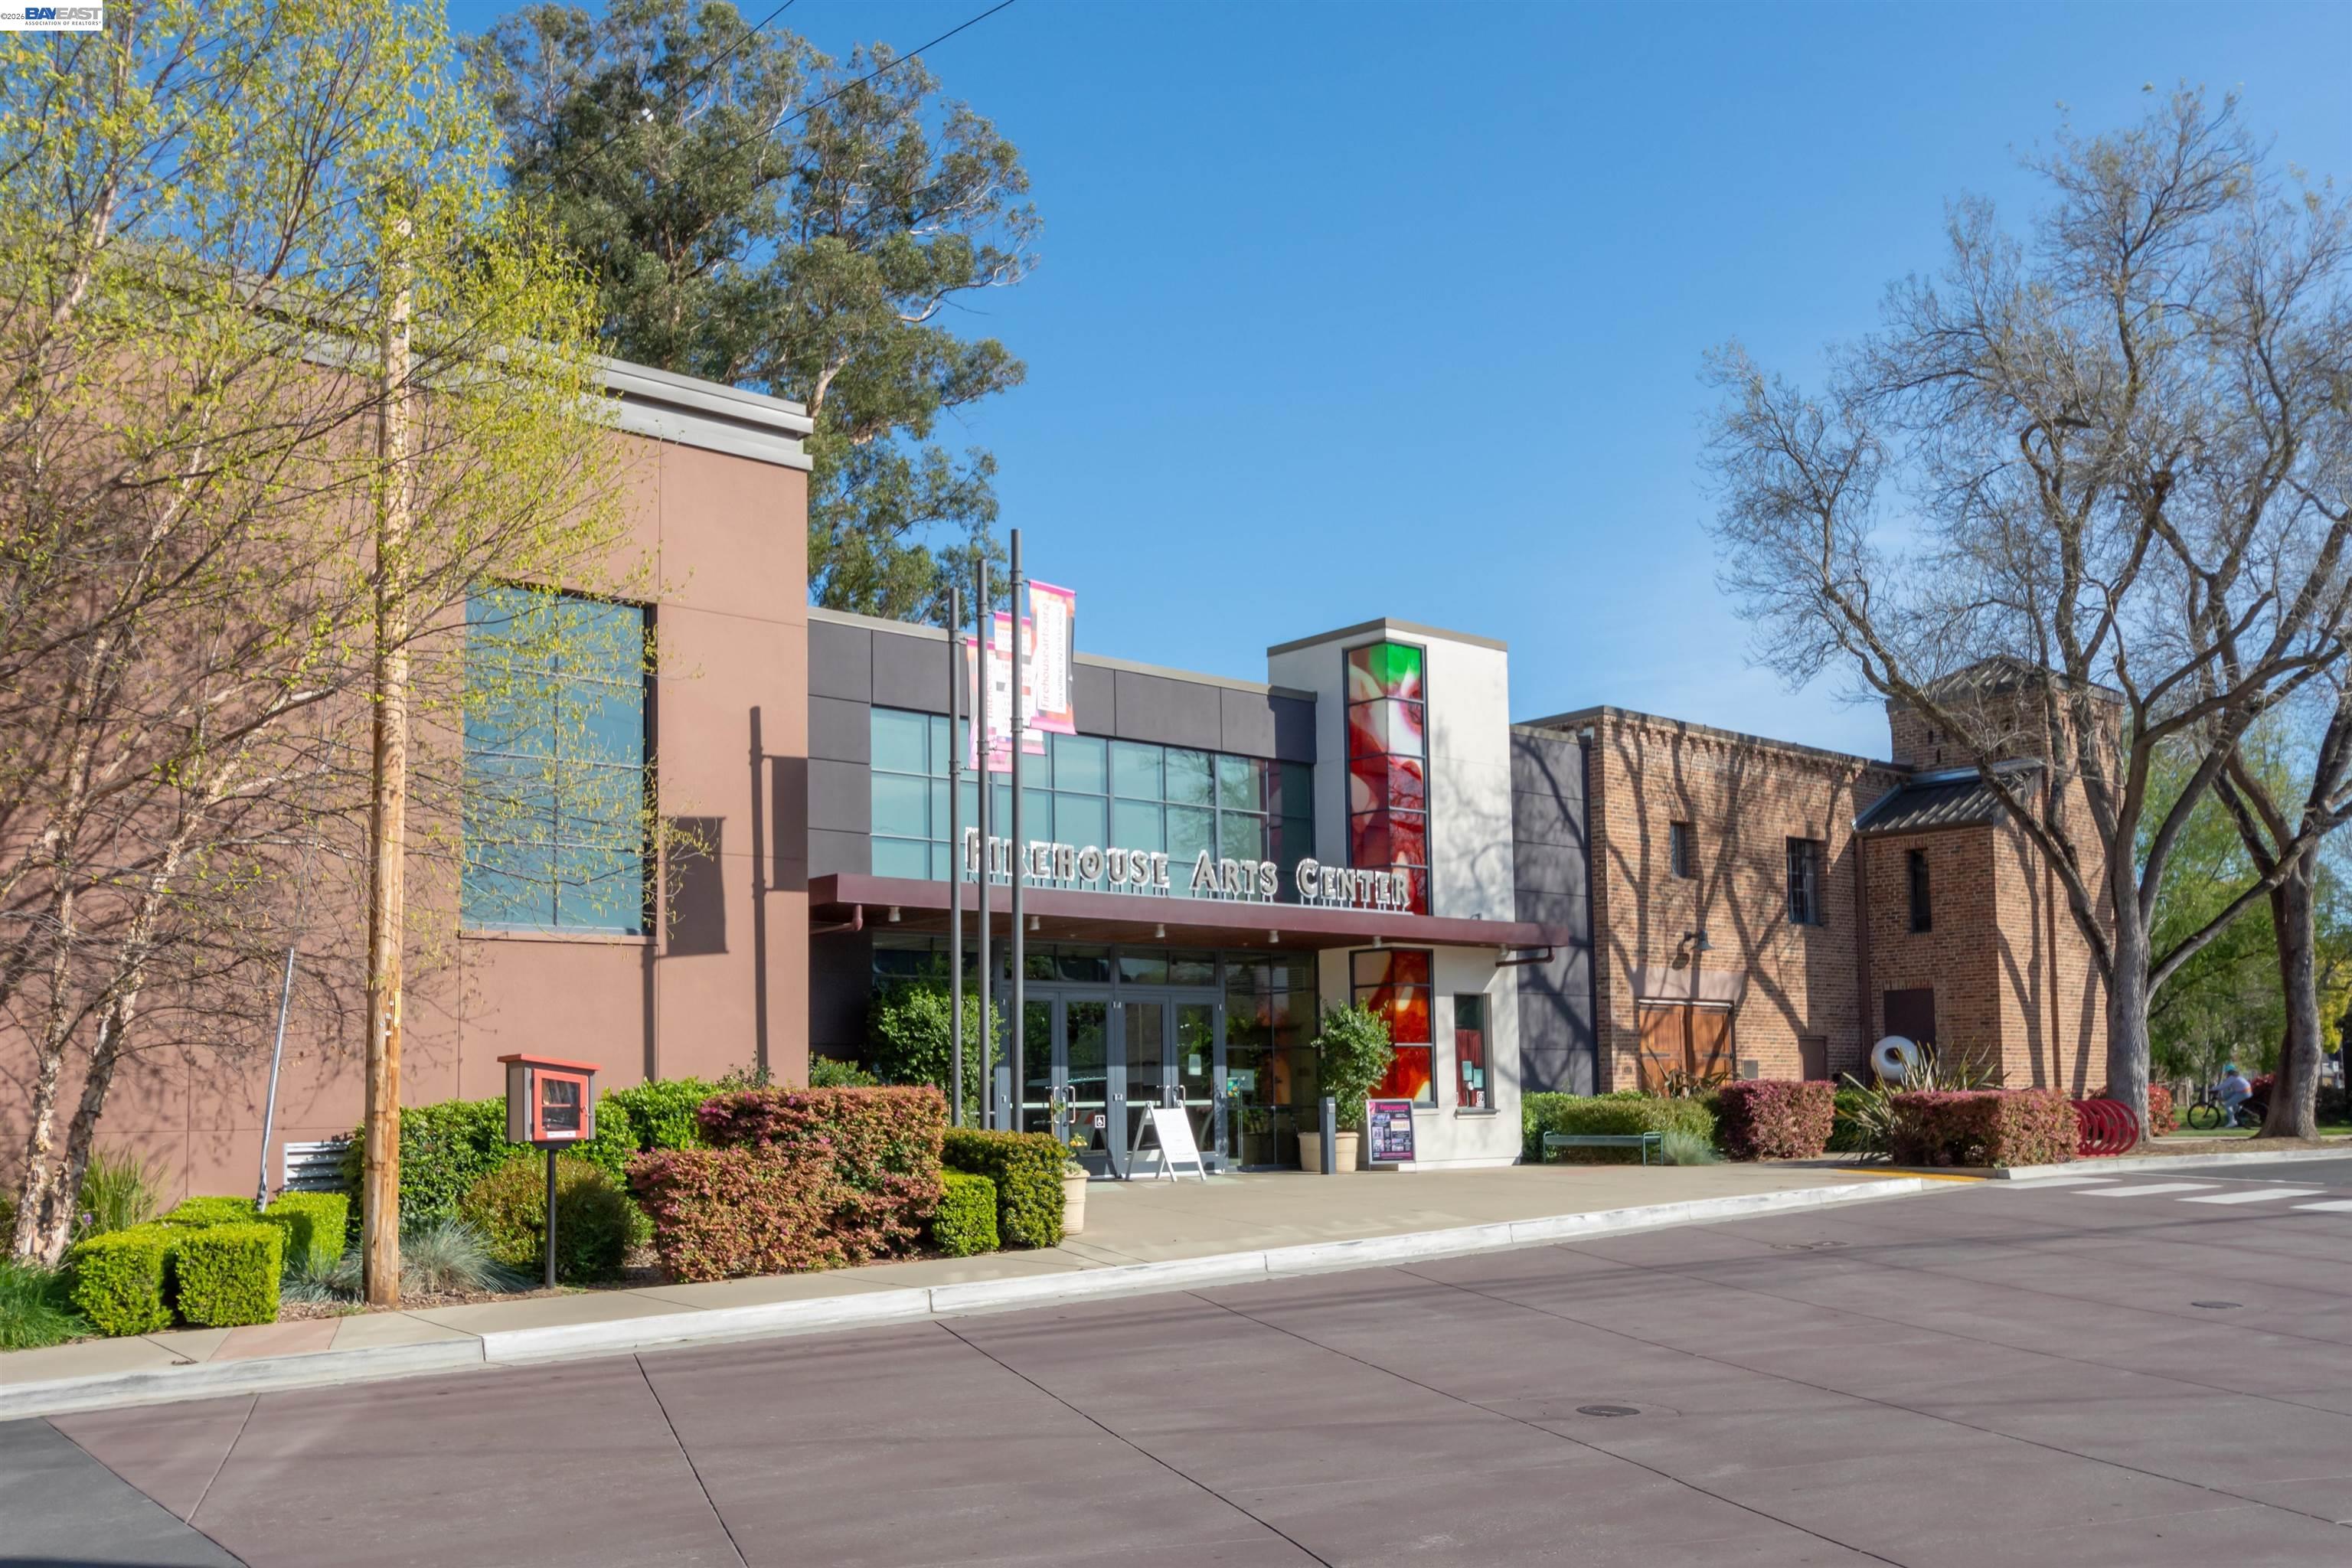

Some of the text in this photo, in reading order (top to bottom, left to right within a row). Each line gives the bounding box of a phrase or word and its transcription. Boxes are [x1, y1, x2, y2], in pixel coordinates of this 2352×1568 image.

[965, 827, 1410, 907] FIREHOUSE ARTS CENTER
